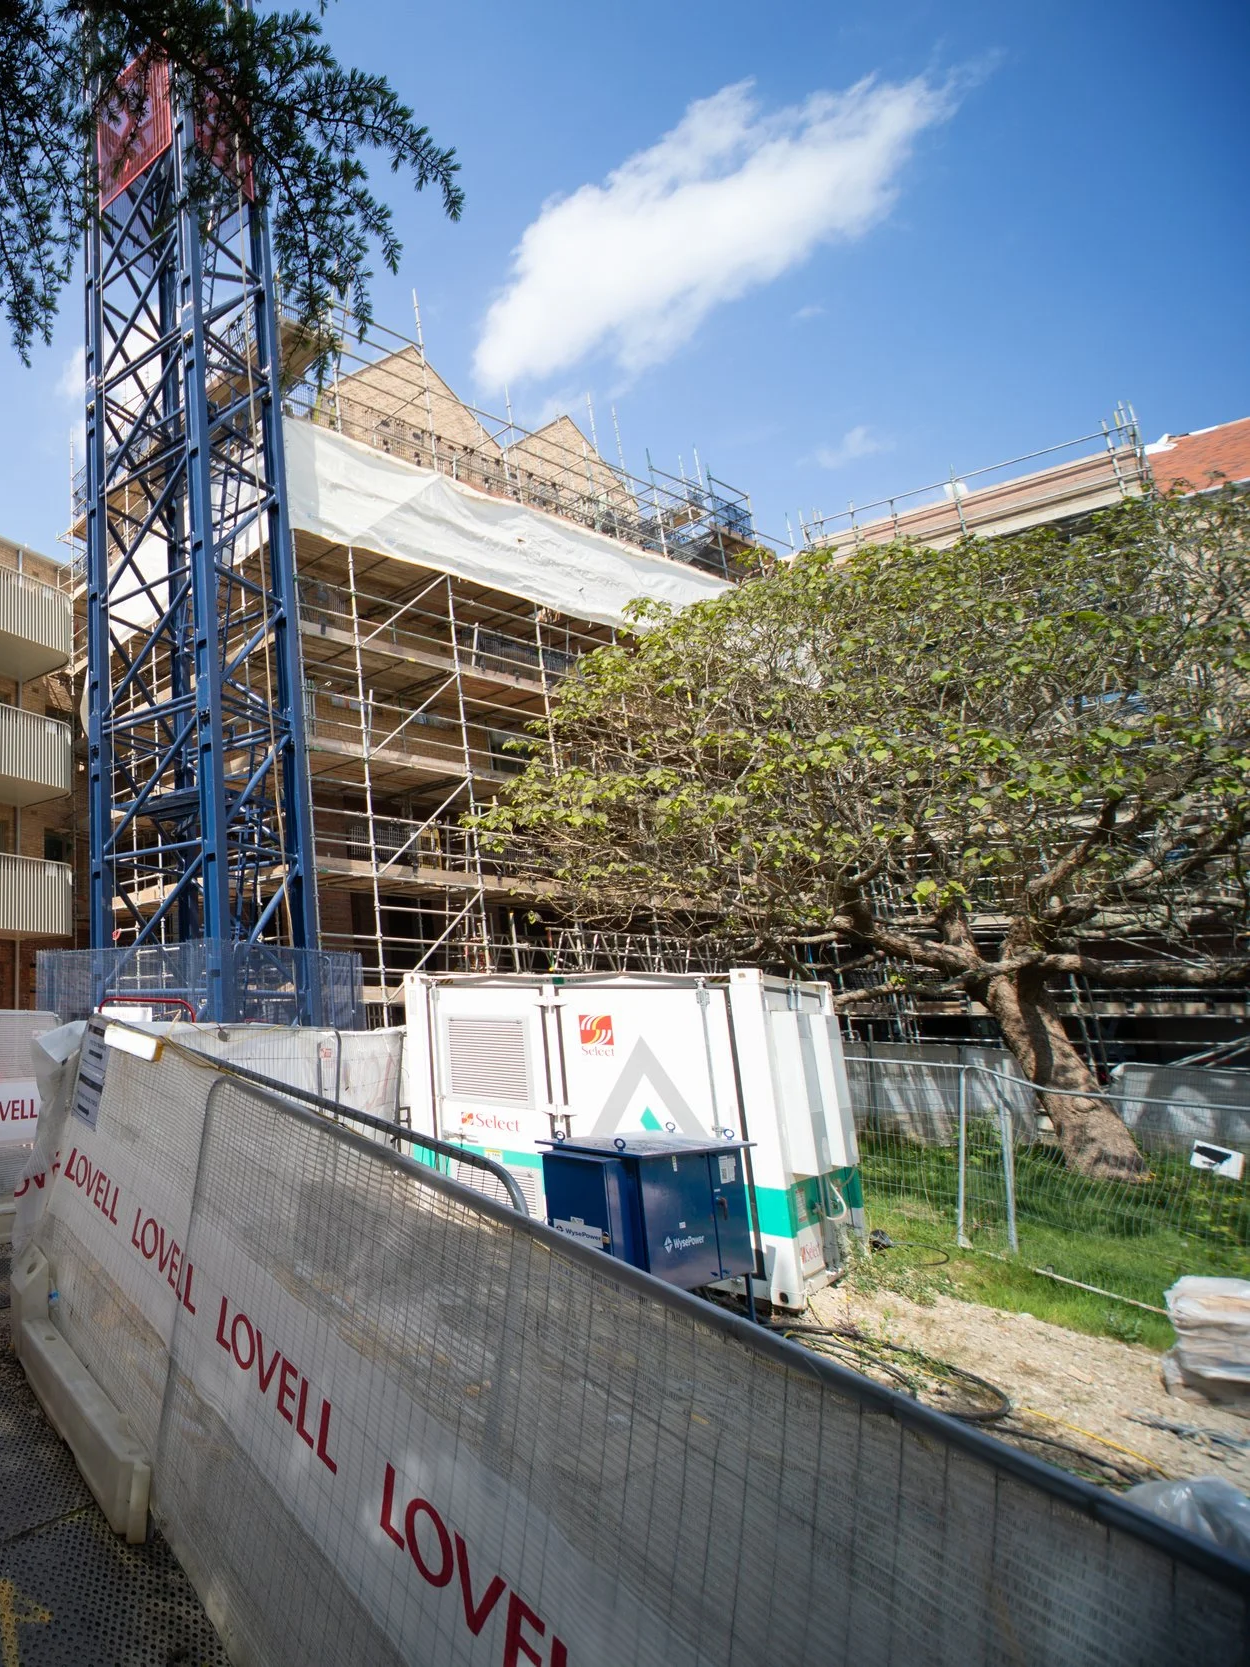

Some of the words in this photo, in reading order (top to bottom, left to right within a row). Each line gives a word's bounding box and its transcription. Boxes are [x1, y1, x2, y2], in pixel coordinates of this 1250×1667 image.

[581, 1046, 615, 1057] Select
[476, 1112, 519, 1132] Select
[565, 1227, 602, 1242] WysePower
[673, 1235, 705, 1250] WysePower
[64, 1147, 119, 1225] LOVELL
[131, 1207, 196, 1315] LOVELL
[216, 1295, 338, 1475] LOVELL
[380, 1462, 568, 1667] LOVE
